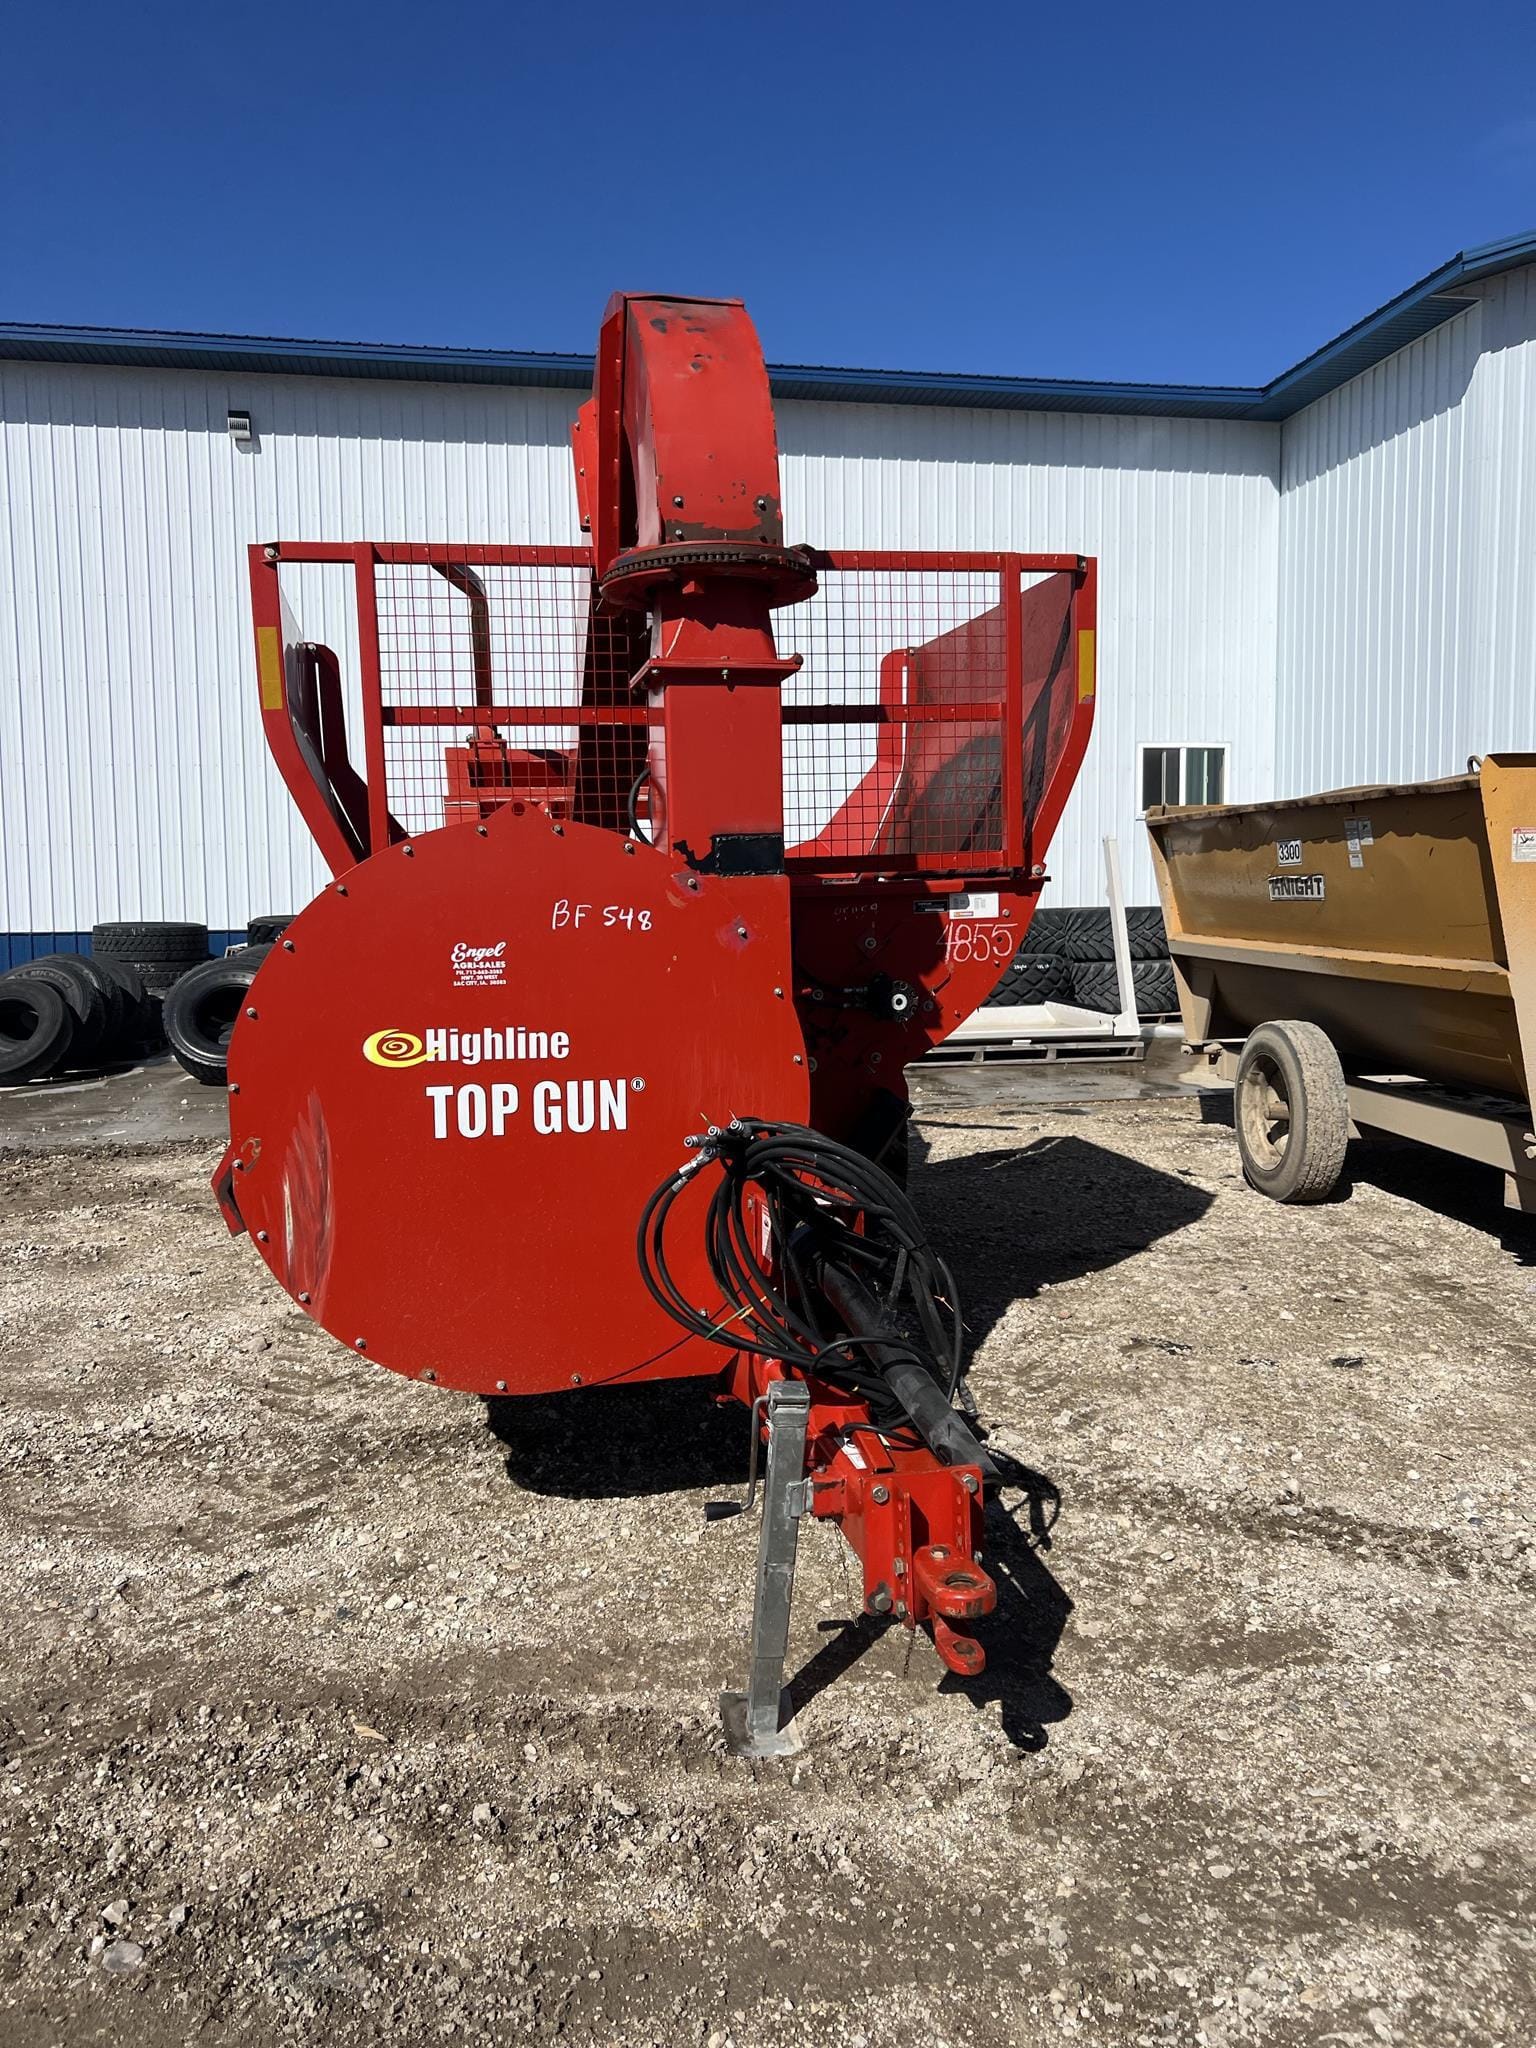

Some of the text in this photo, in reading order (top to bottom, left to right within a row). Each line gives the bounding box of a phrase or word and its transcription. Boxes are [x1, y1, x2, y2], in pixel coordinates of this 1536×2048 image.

[1278, 844, 1300, 861] 3300
[1269, 877, 1322, 896] KNIGHT
[551, 899, 653, 931] BF 548
[451, 942, 506, 962] Engel
[936, 921, 1018, 965] 4855
[452, 961, 506, 969] AGRI-SALES
[425, 1028, 570, 1065] Highline
[424, 1081, 520, 1140] TOP
